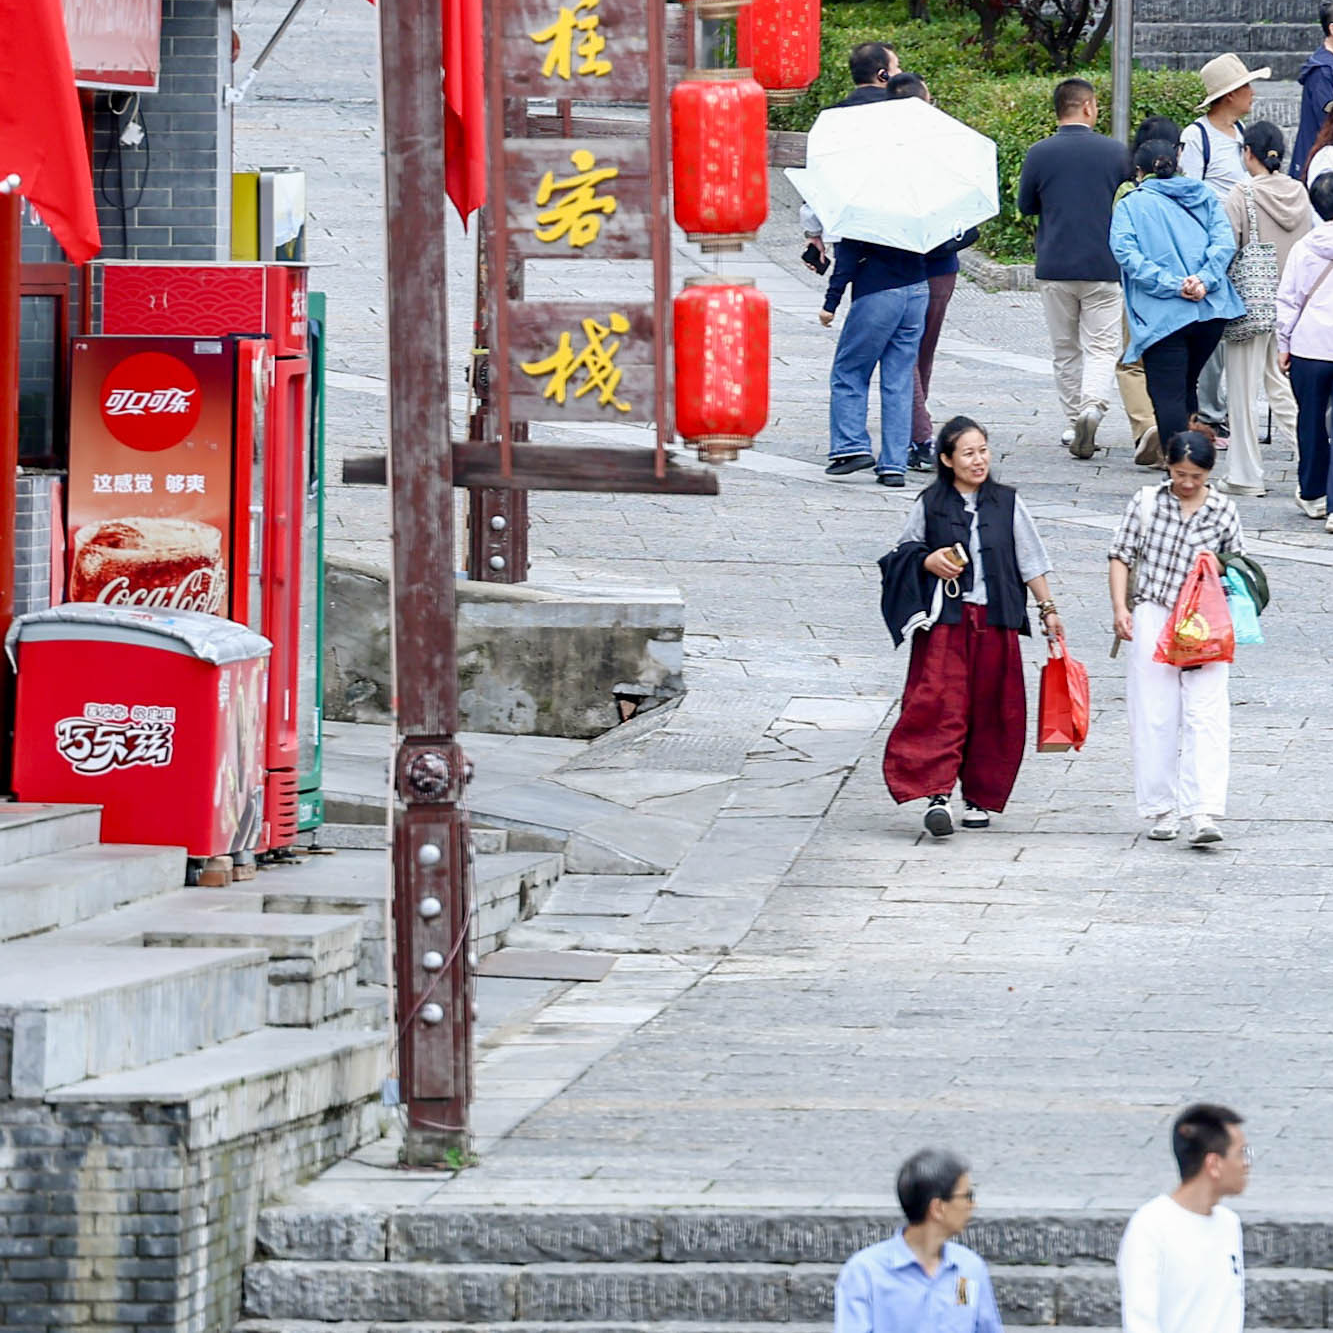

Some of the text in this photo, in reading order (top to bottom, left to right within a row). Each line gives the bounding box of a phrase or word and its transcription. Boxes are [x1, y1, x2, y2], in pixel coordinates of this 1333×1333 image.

[104, 387, 196, 416] 可口可乐
[92, 474, 206, 494] 这感觉 够爽
[57, 719, 172, 774] 巧乐兹
